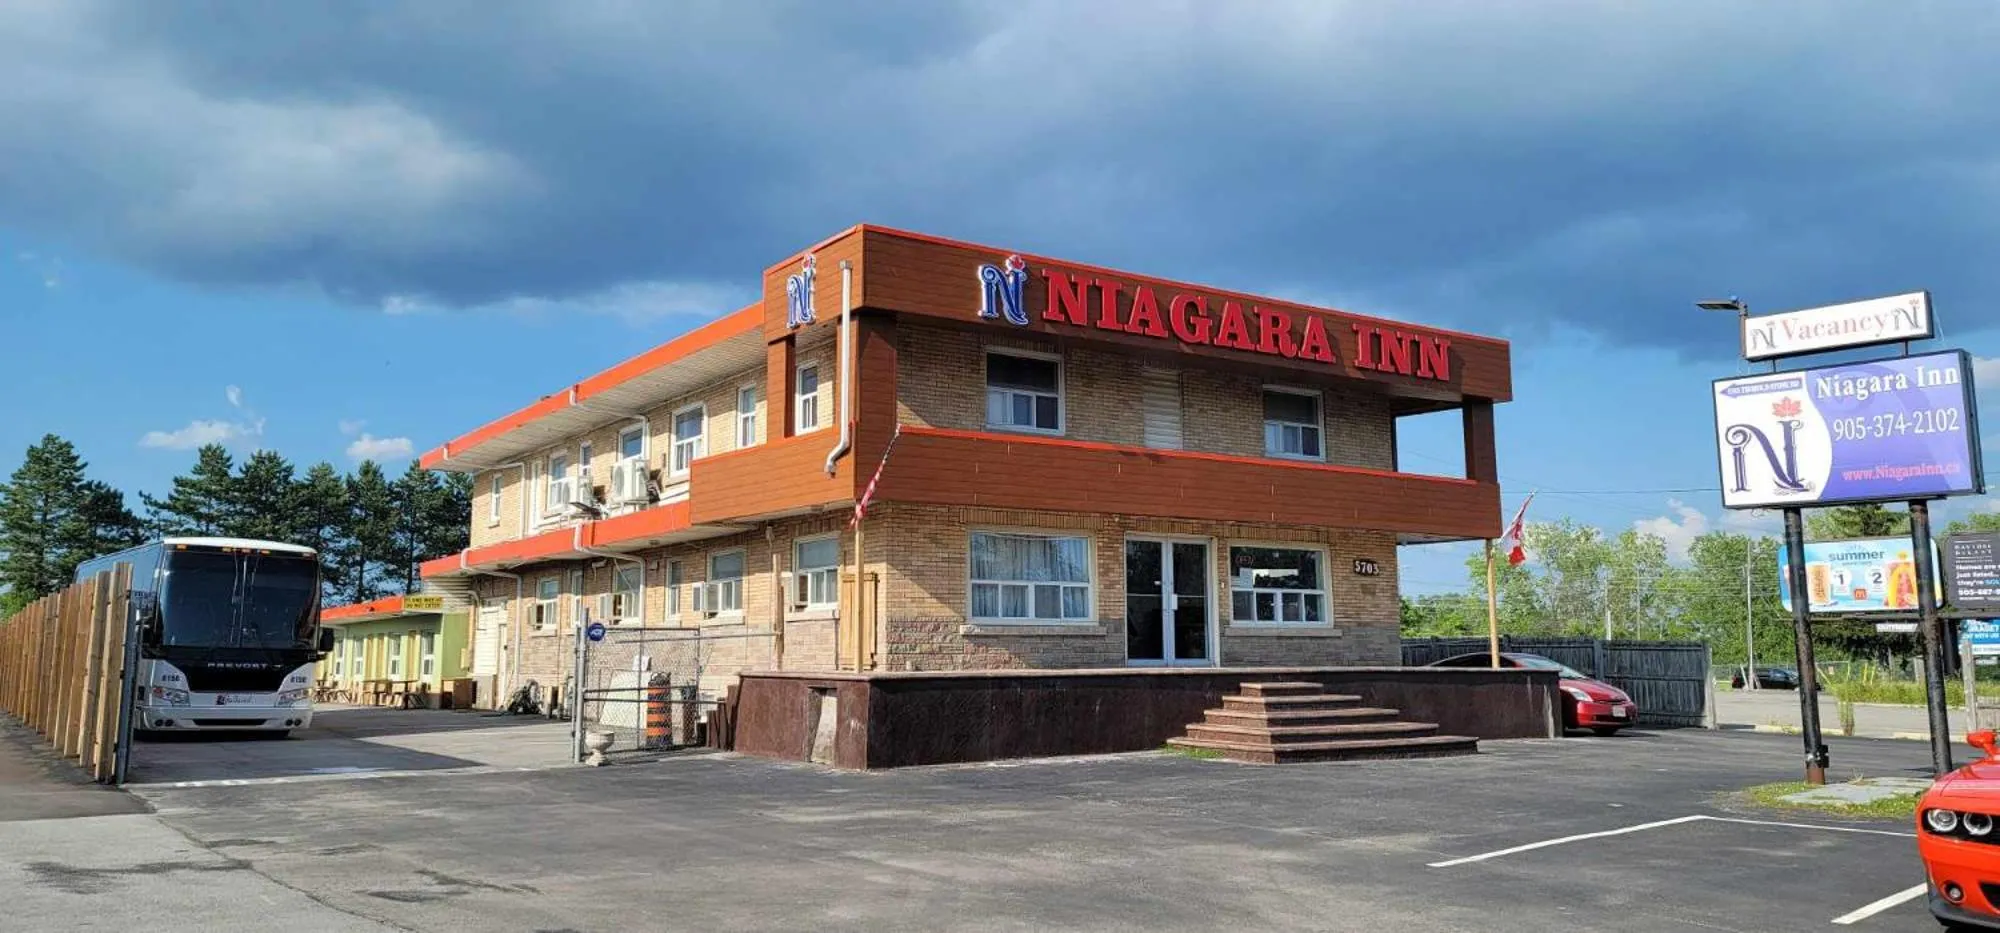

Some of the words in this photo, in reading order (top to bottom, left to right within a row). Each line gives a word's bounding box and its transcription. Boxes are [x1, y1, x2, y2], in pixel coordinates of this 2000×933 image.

[1042, 268, 1336, 364] NIAGARA
[1352, 322, 1450, 381] INN
[1780, 311, 1888, 341] Vacancy
[1816, 373, 1908, 399] Niagara
[1915, 365, 1959, 387] Inn
[1833, 408, 1960, 441] 905-374-2102
[1842, 462, 1961, 481] www.NiagaraInn.ca
[1355, 560, 1379, 576] 5703
[1828, 551, 1885, 562] summer
